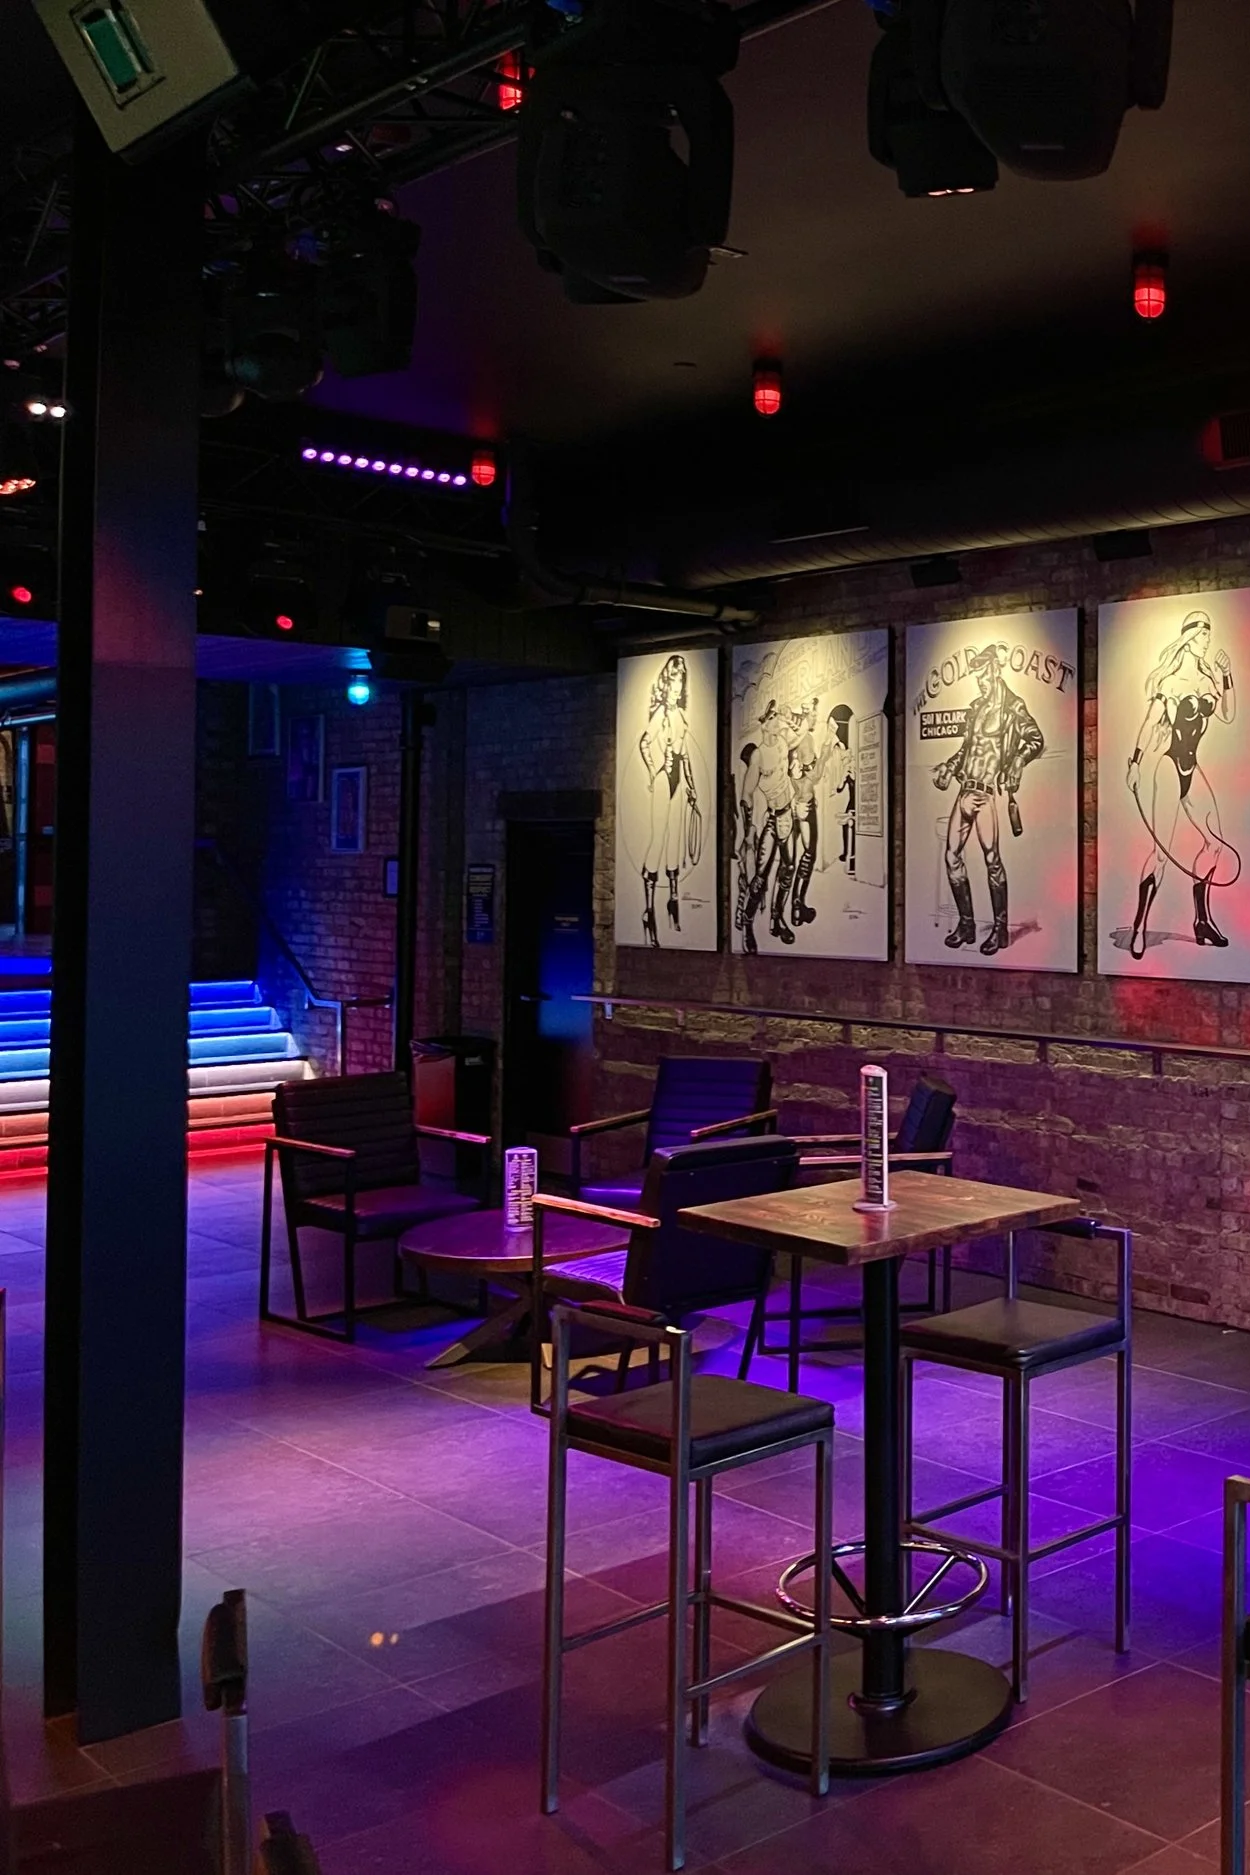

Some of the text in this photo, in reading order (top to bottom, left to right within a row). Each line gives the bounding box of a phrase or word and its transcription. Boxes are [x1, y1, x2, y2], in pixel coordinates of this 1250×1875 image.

[925, 645, 980, 699] GOLD
[995, 640, 1076, 693] COAST
[922, 725, 959, 737] CHICAGO
